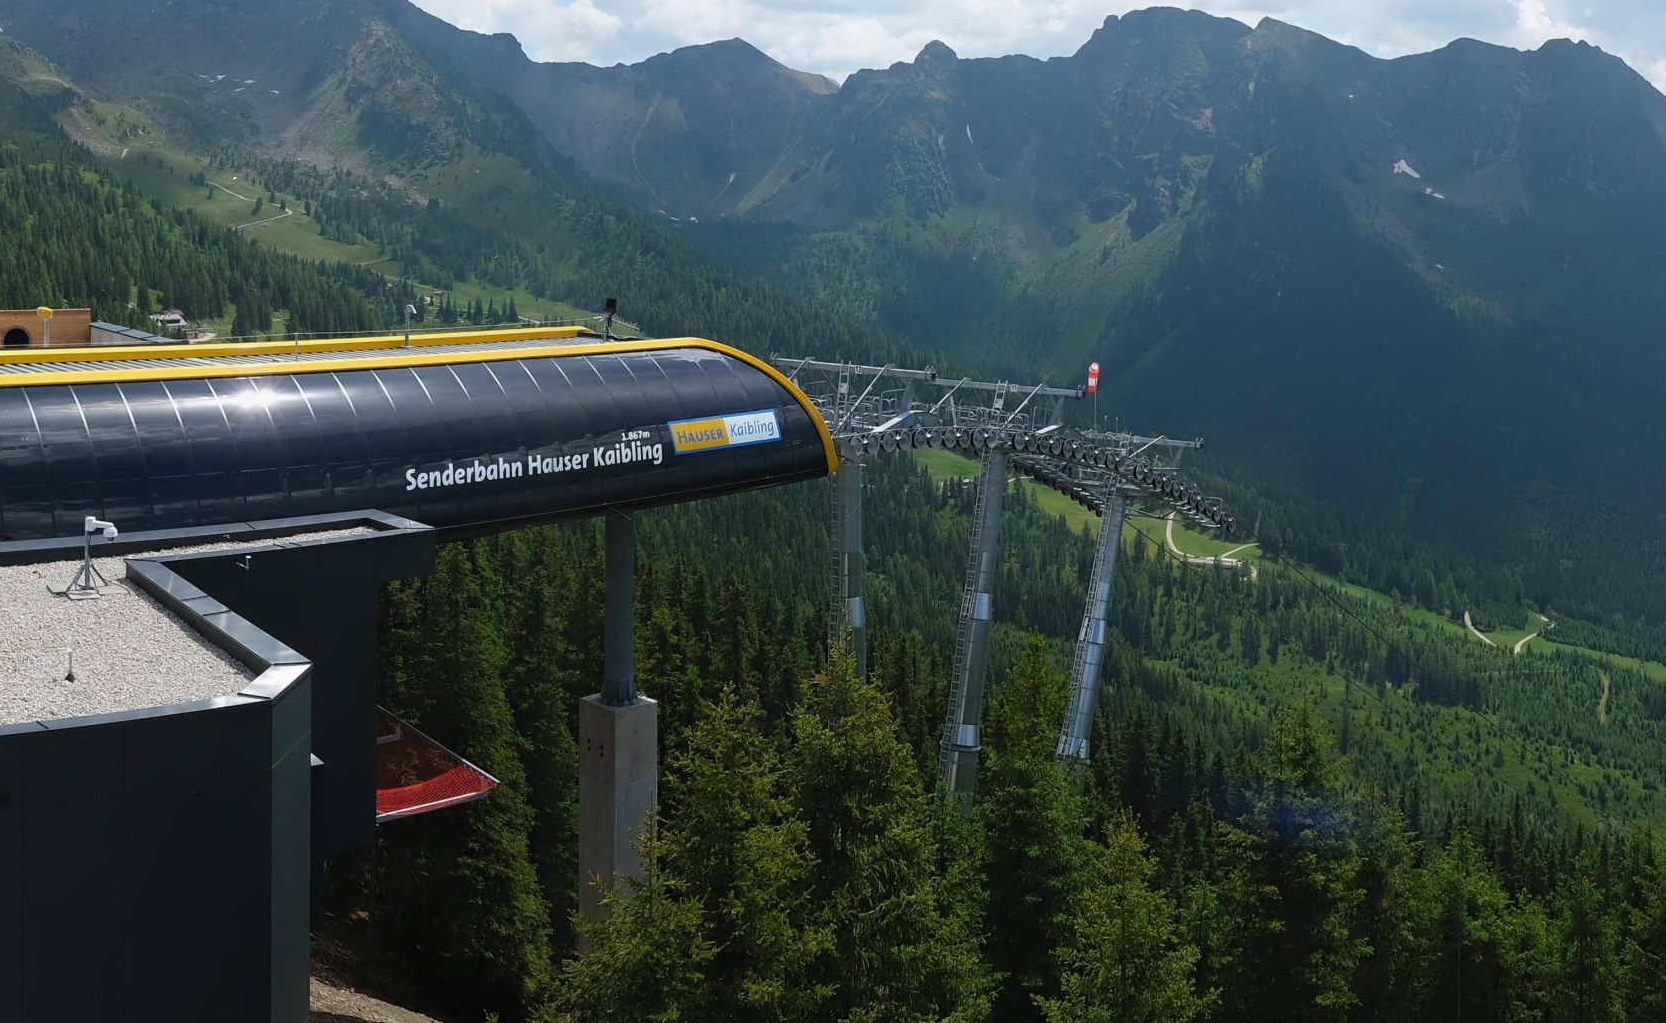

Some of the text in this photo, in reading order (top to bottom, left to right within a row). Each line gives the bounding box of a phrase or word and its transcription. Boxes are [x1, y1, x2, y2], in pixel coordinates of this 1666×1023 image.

[621, 430, 650, 441] 1.867m
[676, 420, 774, 444] HAUSER Kaibling
[405, 441, 663, 491] Senderbahn Hauser Kaibling
